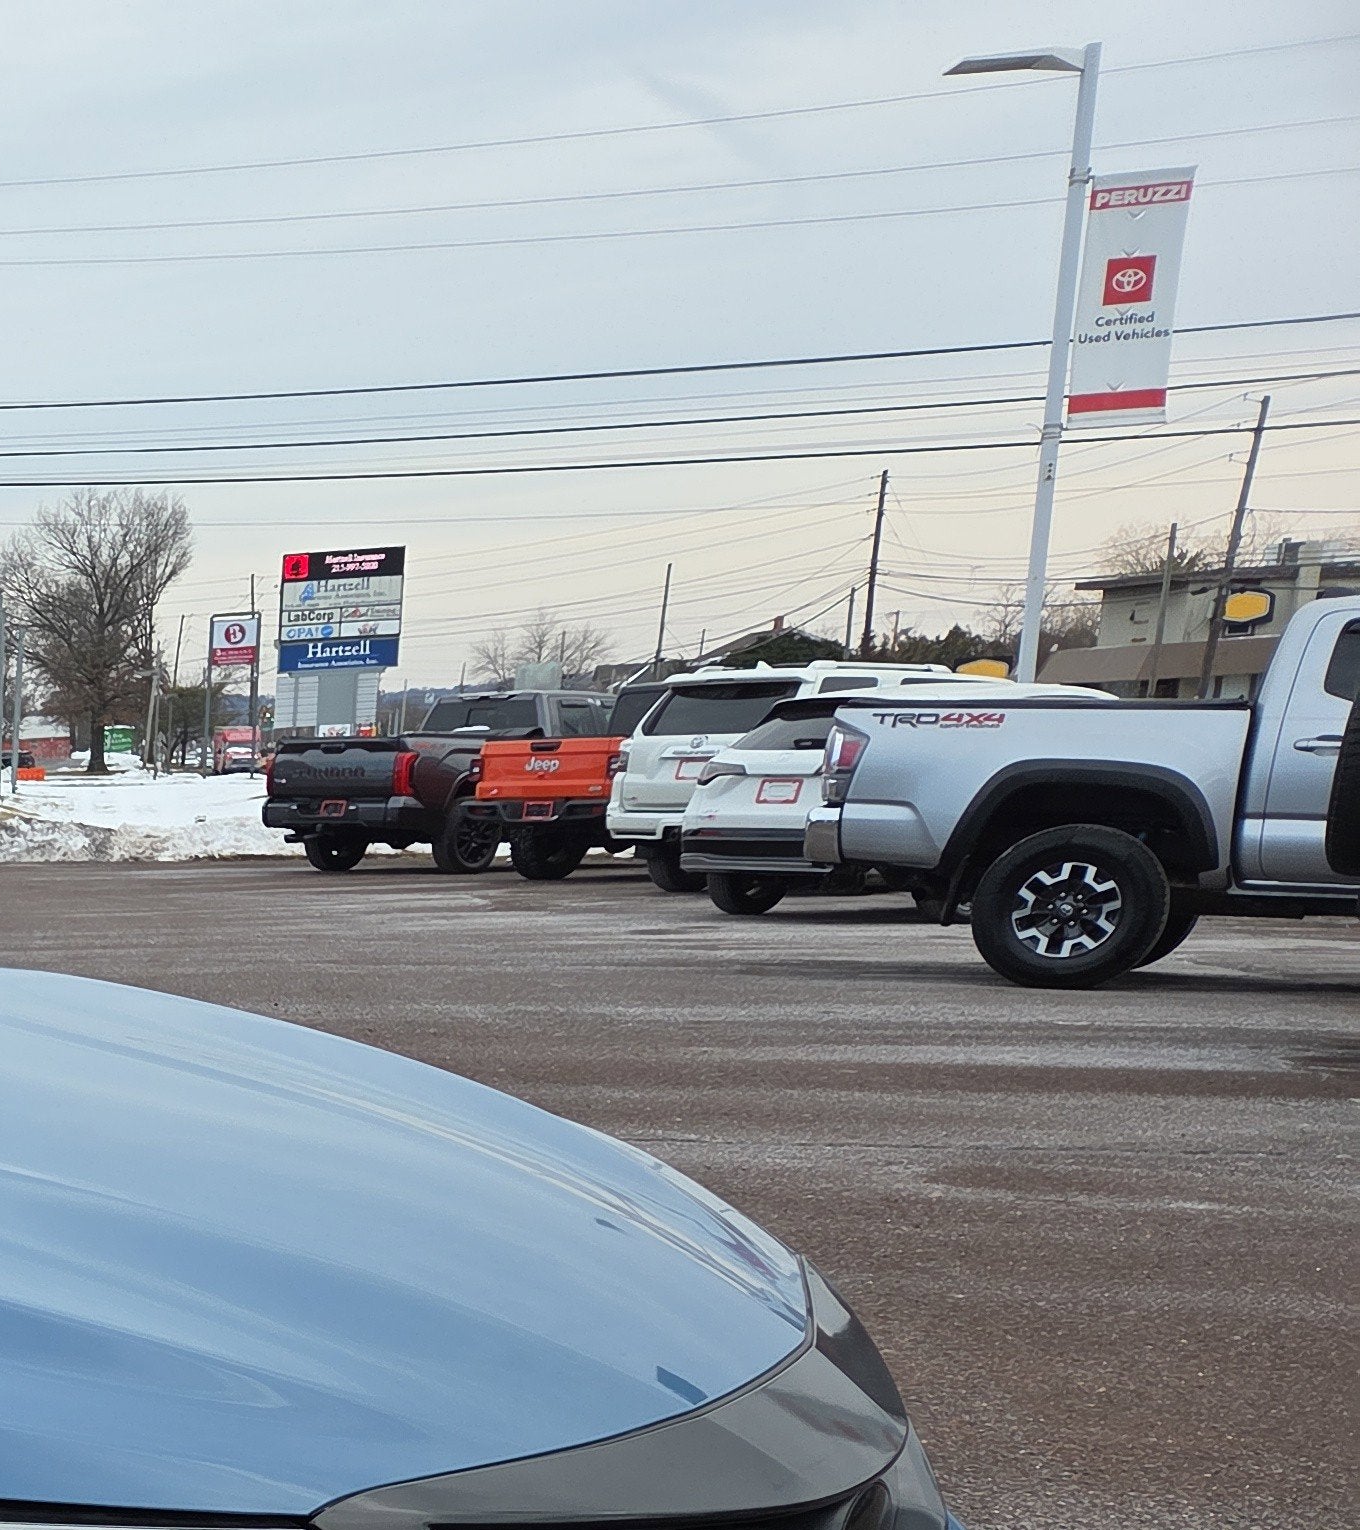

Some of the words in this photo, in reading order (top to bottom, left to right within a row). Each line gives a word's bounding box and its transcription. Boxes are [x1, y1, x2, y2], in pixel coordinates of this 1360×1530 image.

[1095, 184, 1187, 208] PERUZZI
[1095, 311, 1155, 327] Certified
[1078, 331, 1111, 344] Used
[1115, 327, 1170, 340] Vehicles
[317, 577, 370, 592] Hartzell
[288, 610, 334, 623] LabCorp
[307, 640, 370, 658] Hartzell
[872, 713, 940, 728] TRD
[525, 756, 560, 772] Jeep
